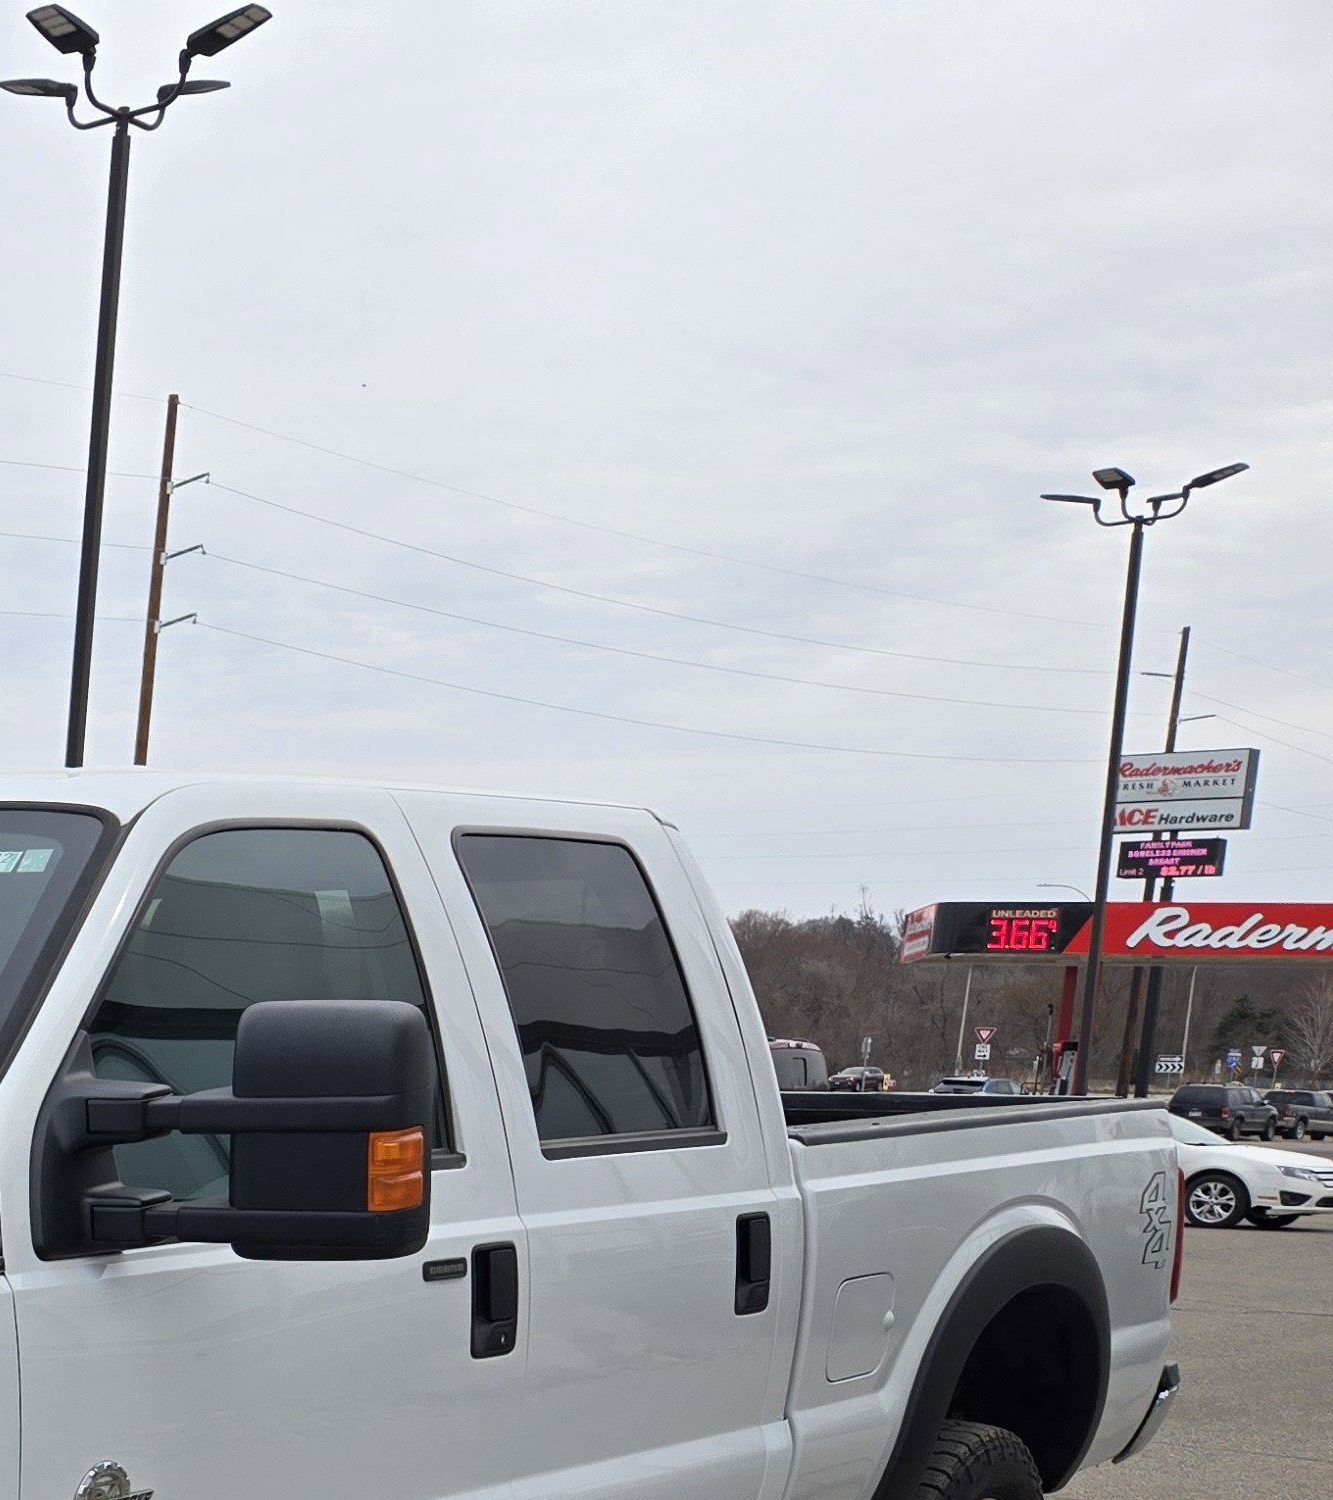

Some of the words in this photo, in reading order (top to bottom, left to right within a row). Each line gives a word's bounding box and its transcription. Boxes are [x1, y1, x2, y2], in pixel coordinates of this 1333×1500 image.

[1119, 759, 1243, 778] Radermacher's
[1122, 782, 1154, 790] RESH
[1182, 778, 1236, 788] MARKET
[1114, 807, 1158, 827] ACE
[1157, 813, 1234, 825] Hardware
[992, 909, 1057, 918] UNLEADED
